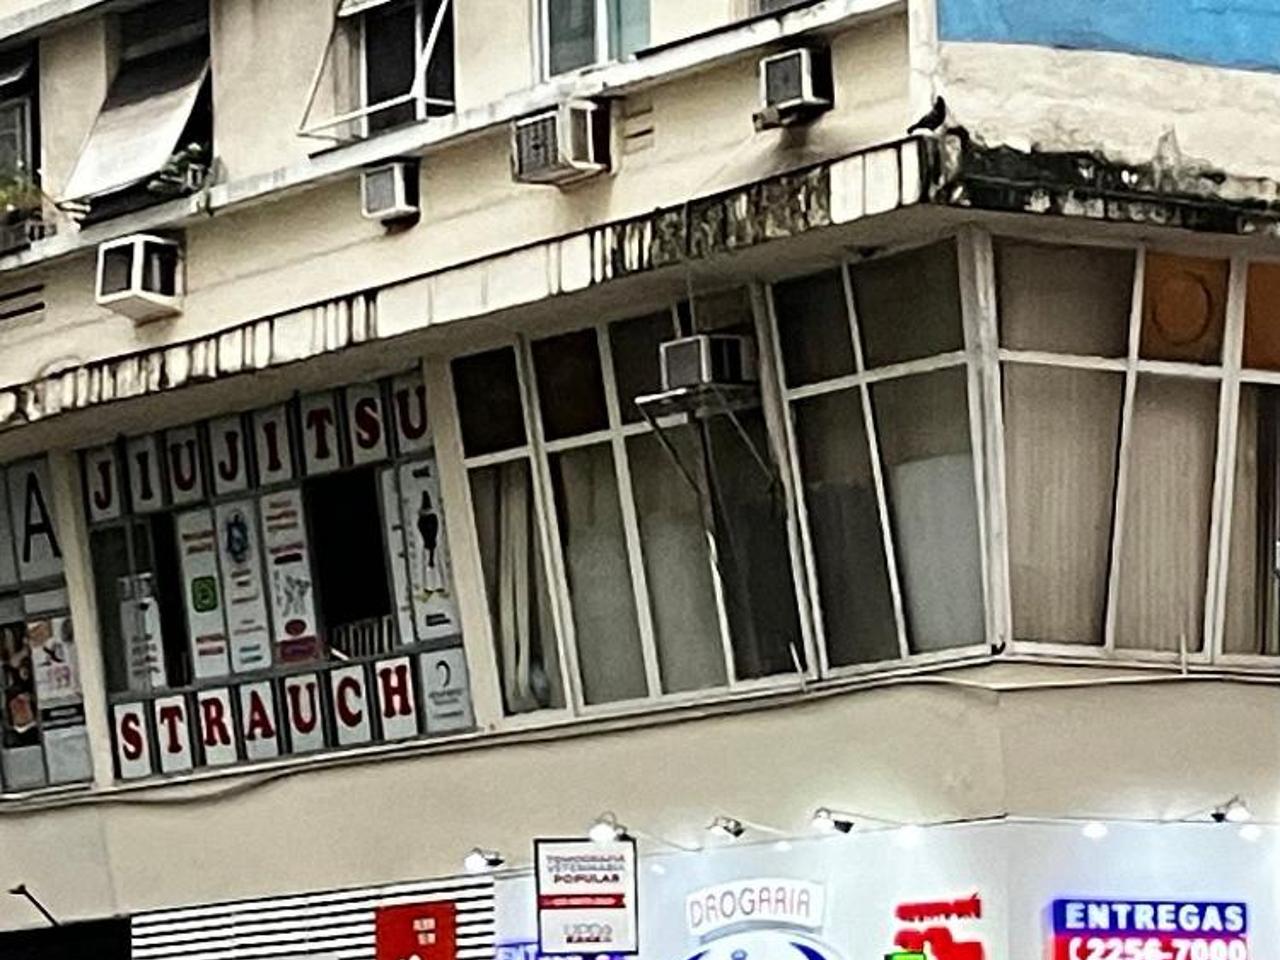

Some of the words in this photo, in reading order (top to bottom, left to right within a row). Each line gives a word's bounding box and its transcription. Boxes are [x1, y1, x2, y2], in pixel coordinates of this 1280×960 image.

[119, 664, 413, 761] STRAUCH
[554, 873, 620, 884] POPULAR
[690, 886, 811, 928] DROGARIA
[1065, 902, 1244, 931] ENTREGAS
